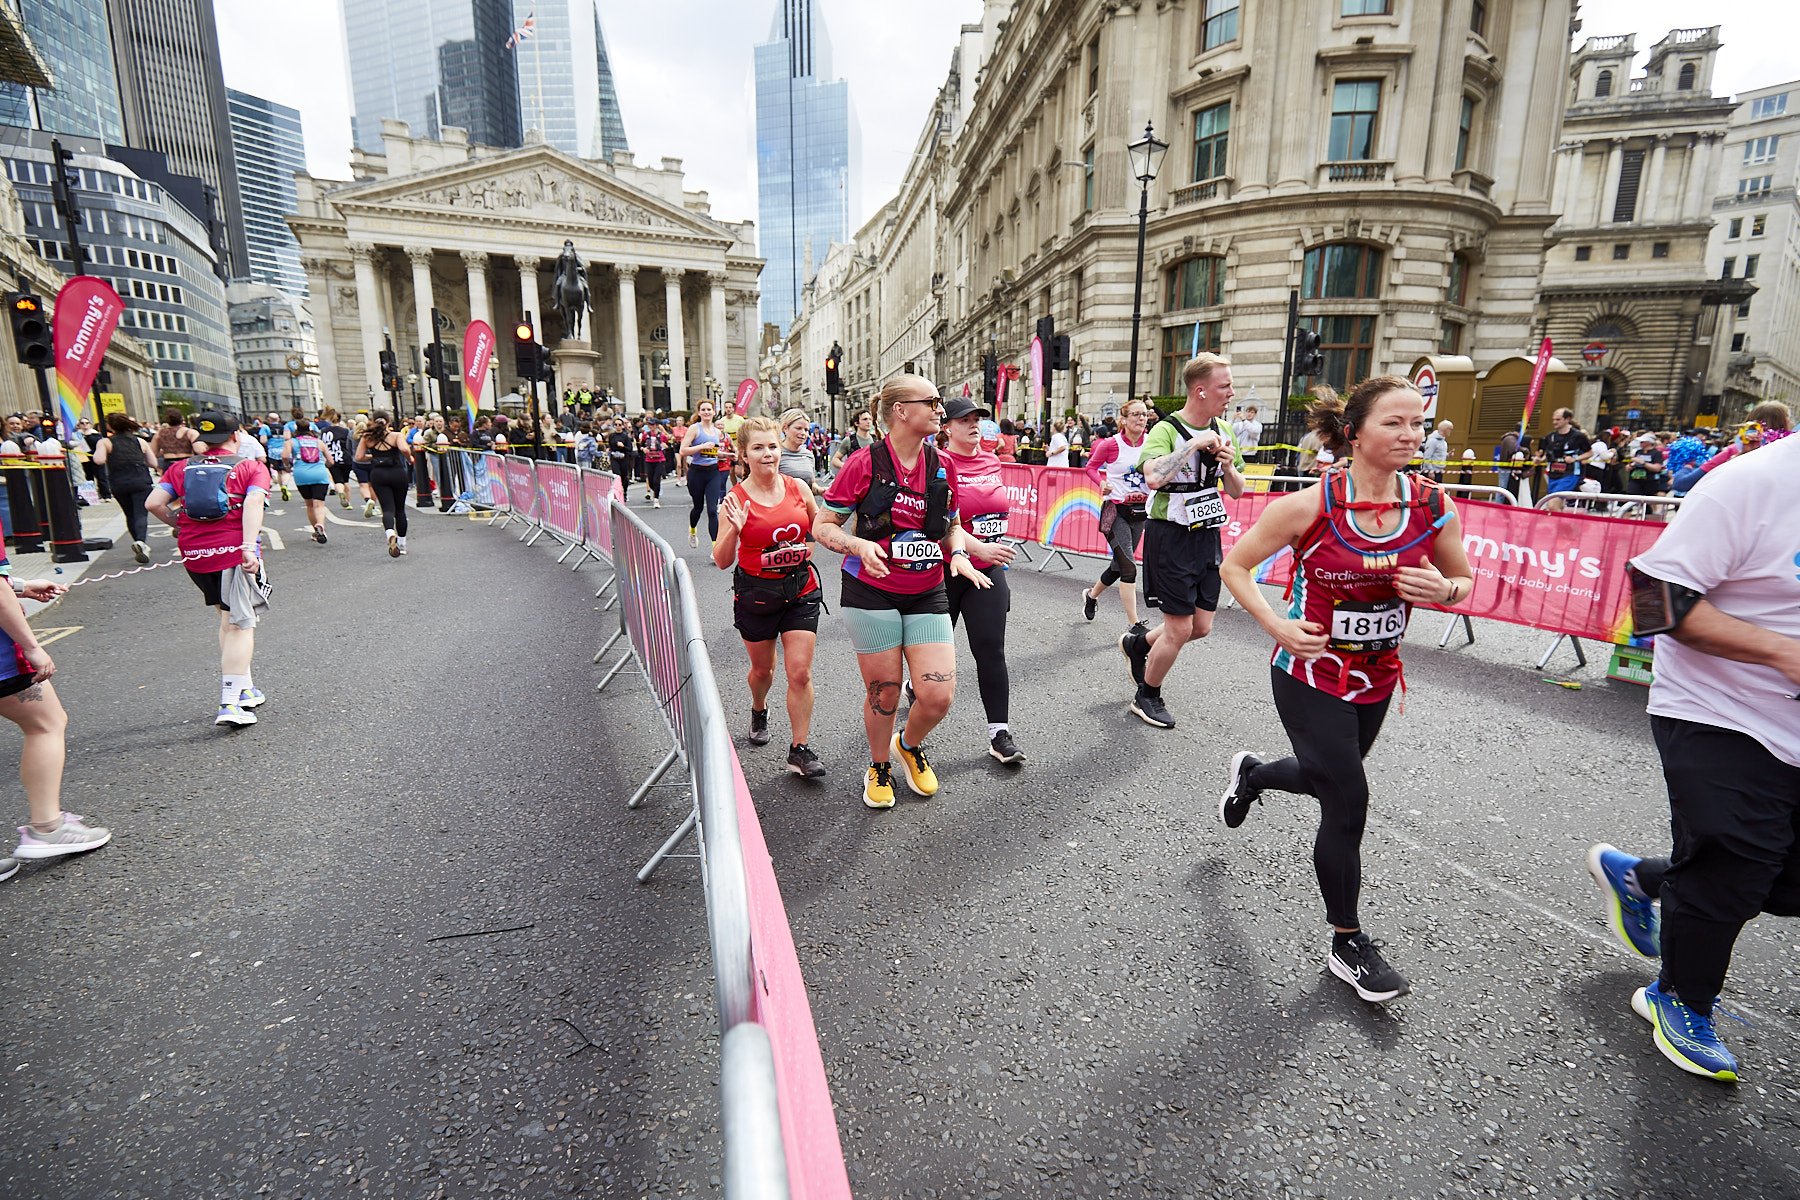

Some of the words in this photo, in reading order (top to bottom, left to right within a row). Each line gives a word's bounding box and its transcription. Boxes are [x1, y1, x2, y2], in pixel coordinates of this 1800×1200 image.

[66, 295, 104, 361] Tommy's
[468, 332, 487, 378] Tommy's
[1001, 484, 1038, 506] my's
[1190, 501, 1224, 519] 18268
[979, 521, 1003, 534] 9321
[897, 543, 941, 558] 10602
[1362, 551, 1399, 570] NAY
[1463, 533, 1601, 579] mmy's
[1519, 576, 1552, 593] baby
[1556, 583, 1601, 601] charity
